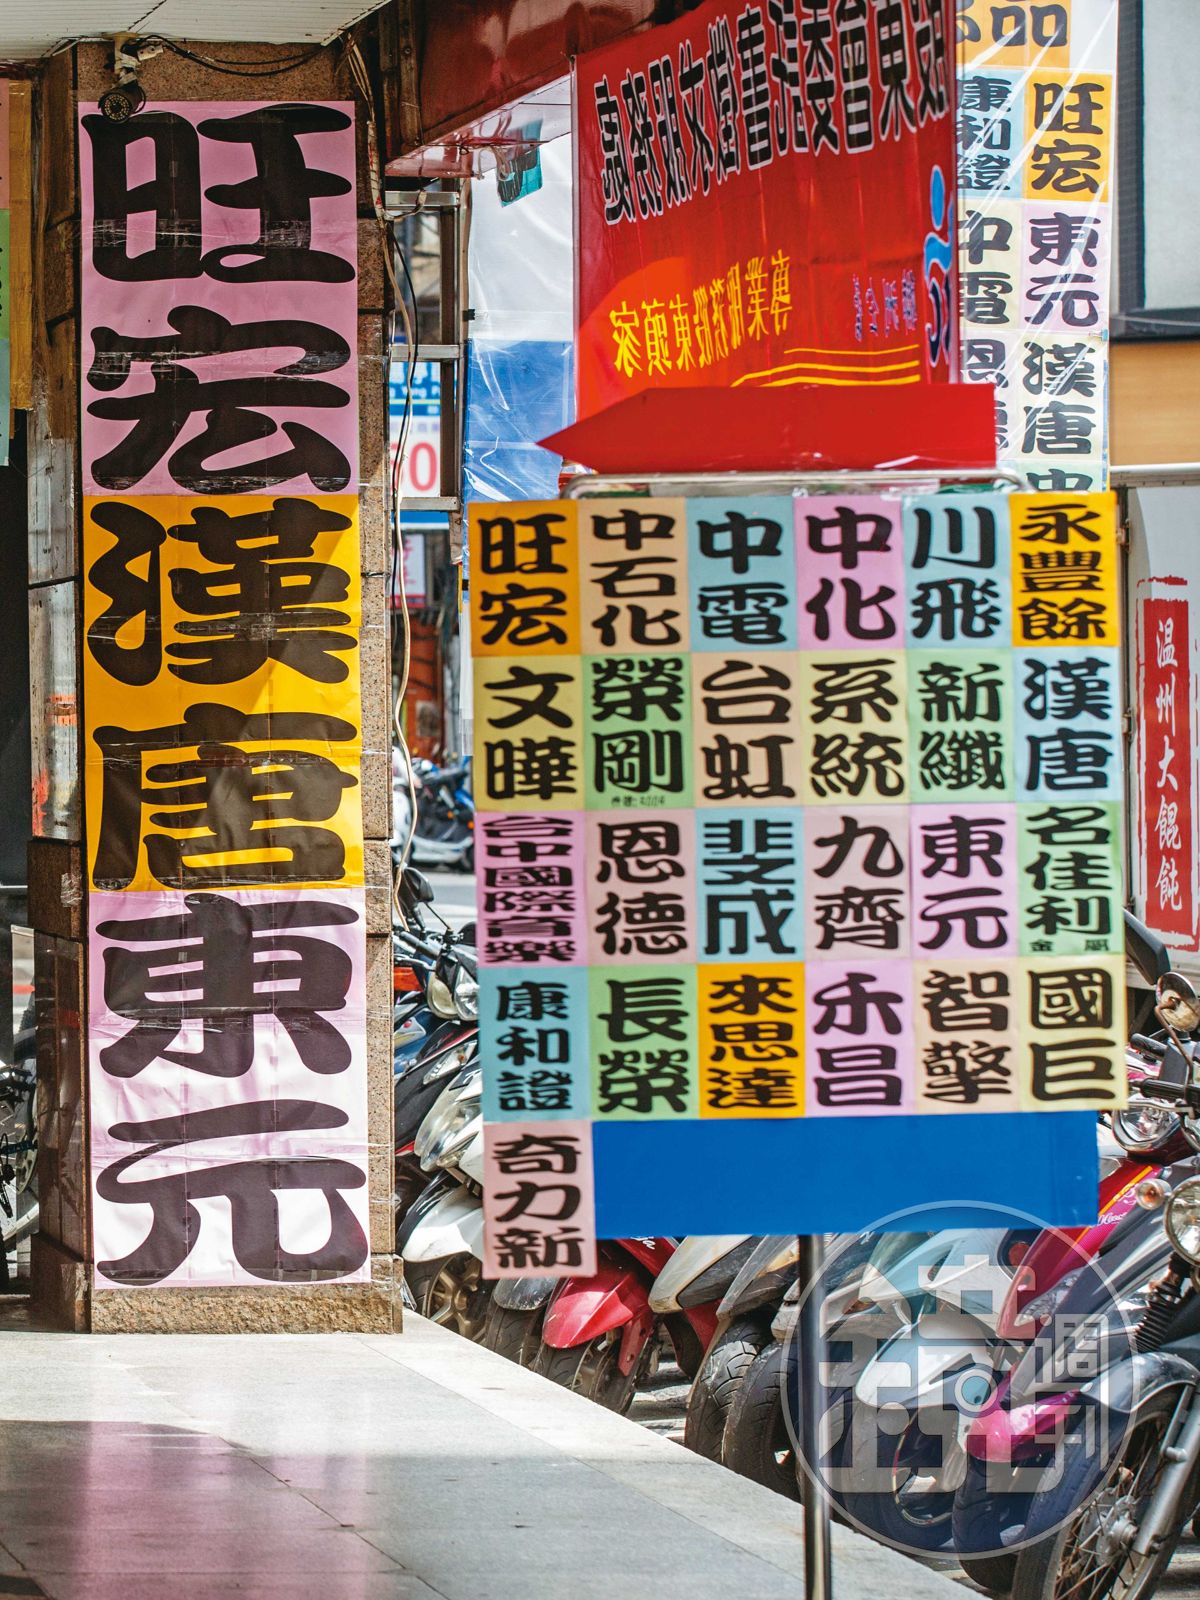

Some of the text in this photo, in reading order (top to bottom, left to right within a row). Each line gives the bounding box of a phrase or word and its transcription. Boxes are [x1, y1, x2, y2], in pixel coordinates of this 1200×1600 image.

[1031, 82, 1105, 194] 旺宏
[81, 103, 356, 494] 旺宏
[959, 210, 1013, 325] 中電
[1025, 212, 1101, 327] 東元
[1021, 341, 1097, 454] 漢唐
[476, 513, 569, 648] 旺宏
[590, 509, 681, 646] 中石化
[696, 512, 789, 644] 中電
[805, 507, 894, 642] 中化
[911, 507, 1001, 640] 川飛
[1018, 504, 1106, 638] 永豐餘
[87, 498, 359, 890] 漢唐
[483, 666, 577, 798] 文曄
[591, 658, 684, 794] 榮剛
[701, 661, 794, 794] 台虹
[810, 659, 897, 792] 系統
[918, 663, 1006, 790] 新纖
[1023, 658, 1113, 788] 漢唐
[483, 816, 576, 962] 台中國際育樂
[595, 821, 688, 954] 恩德
[703, 820, 796, 952] 斐成
[814, 816, 901, 950] 九齊
[919, 816, 1008, 948] 東元
[1025, 807, 1111, 937] 名佳利
[96, 893, 368, 1286] 東元
[496, 981, 573, 1112] 康和證
[597, 978, 690, 1110] 長榮
[707, 975, 799, 1108] 來思達
[922, 971, 1012, 1104] 智擎
[1028, 969, 1116, 1102] 國巨
[493, 1134, 584, 1270] 奇力新
